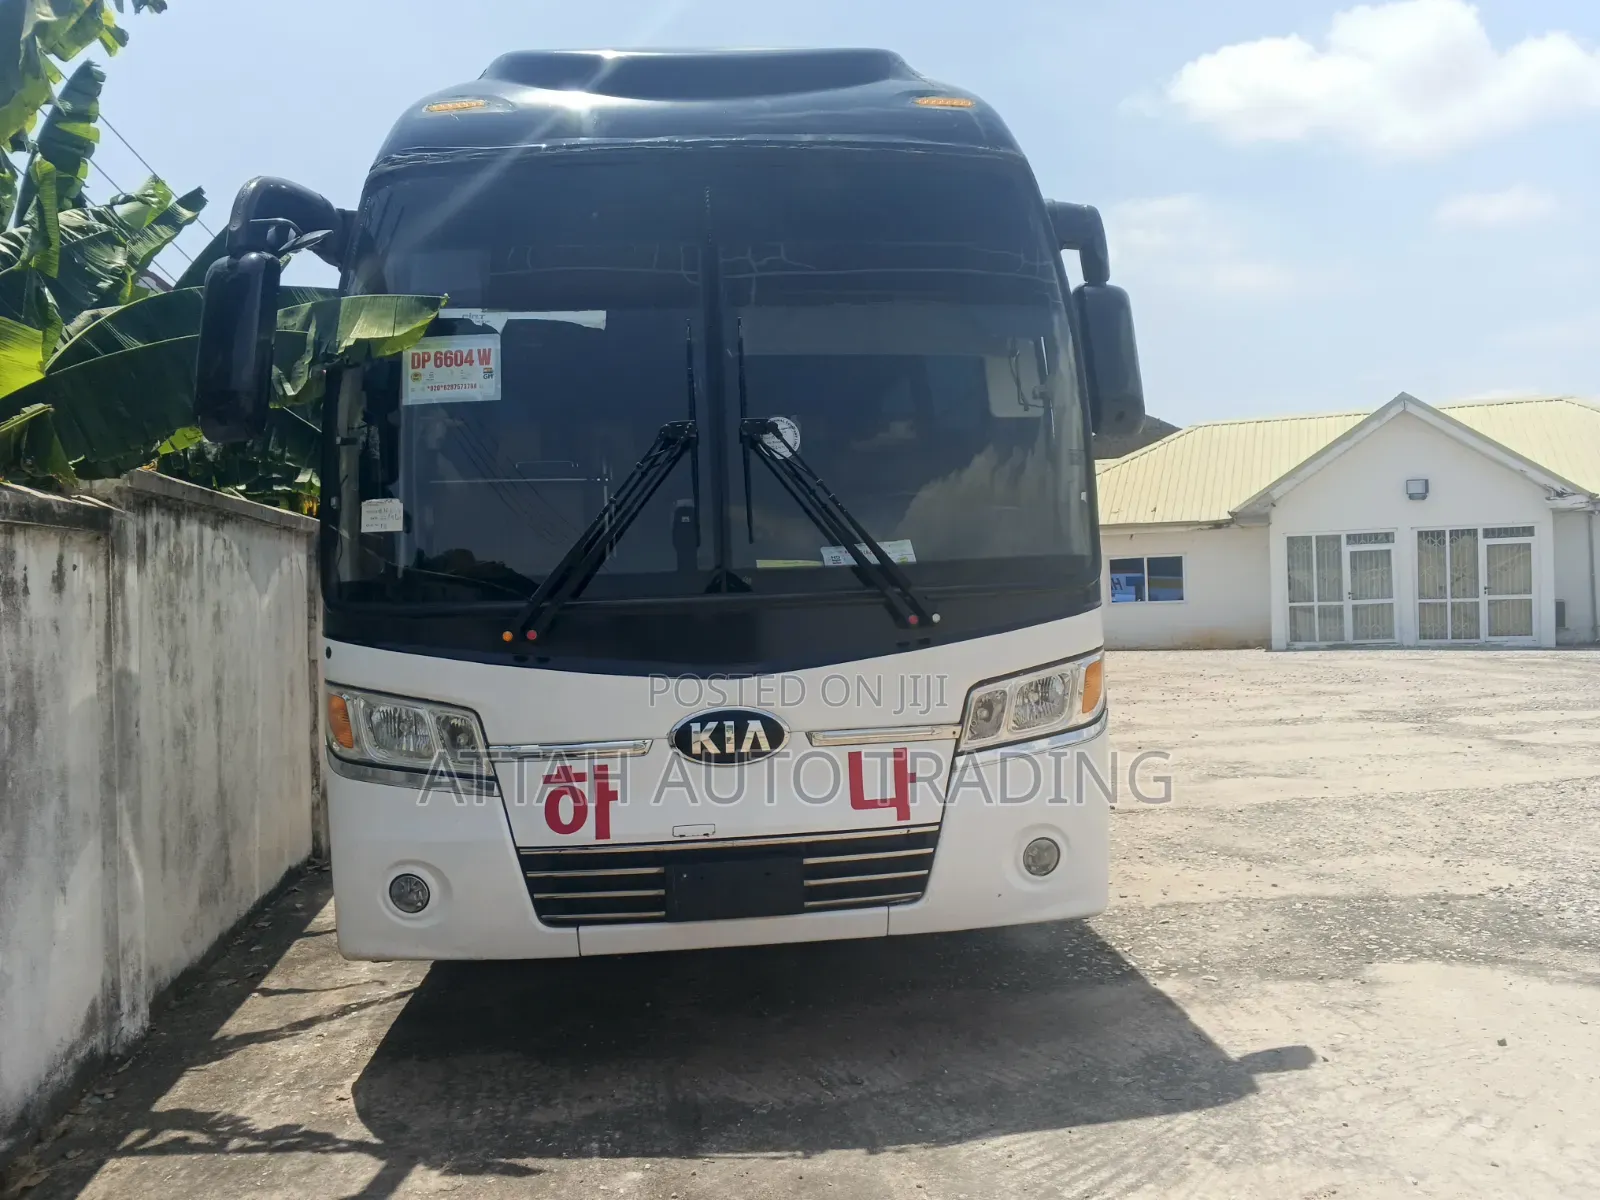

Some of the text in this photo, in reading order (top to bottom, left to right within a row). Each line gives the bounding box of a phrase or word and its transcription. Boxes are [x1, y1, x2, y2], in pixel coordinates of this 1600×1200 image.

[411, 347, 492, 370] DP 6604 W
[689, 719, 772, 755] KIA
[542, 746, 916, 840] 하 나
